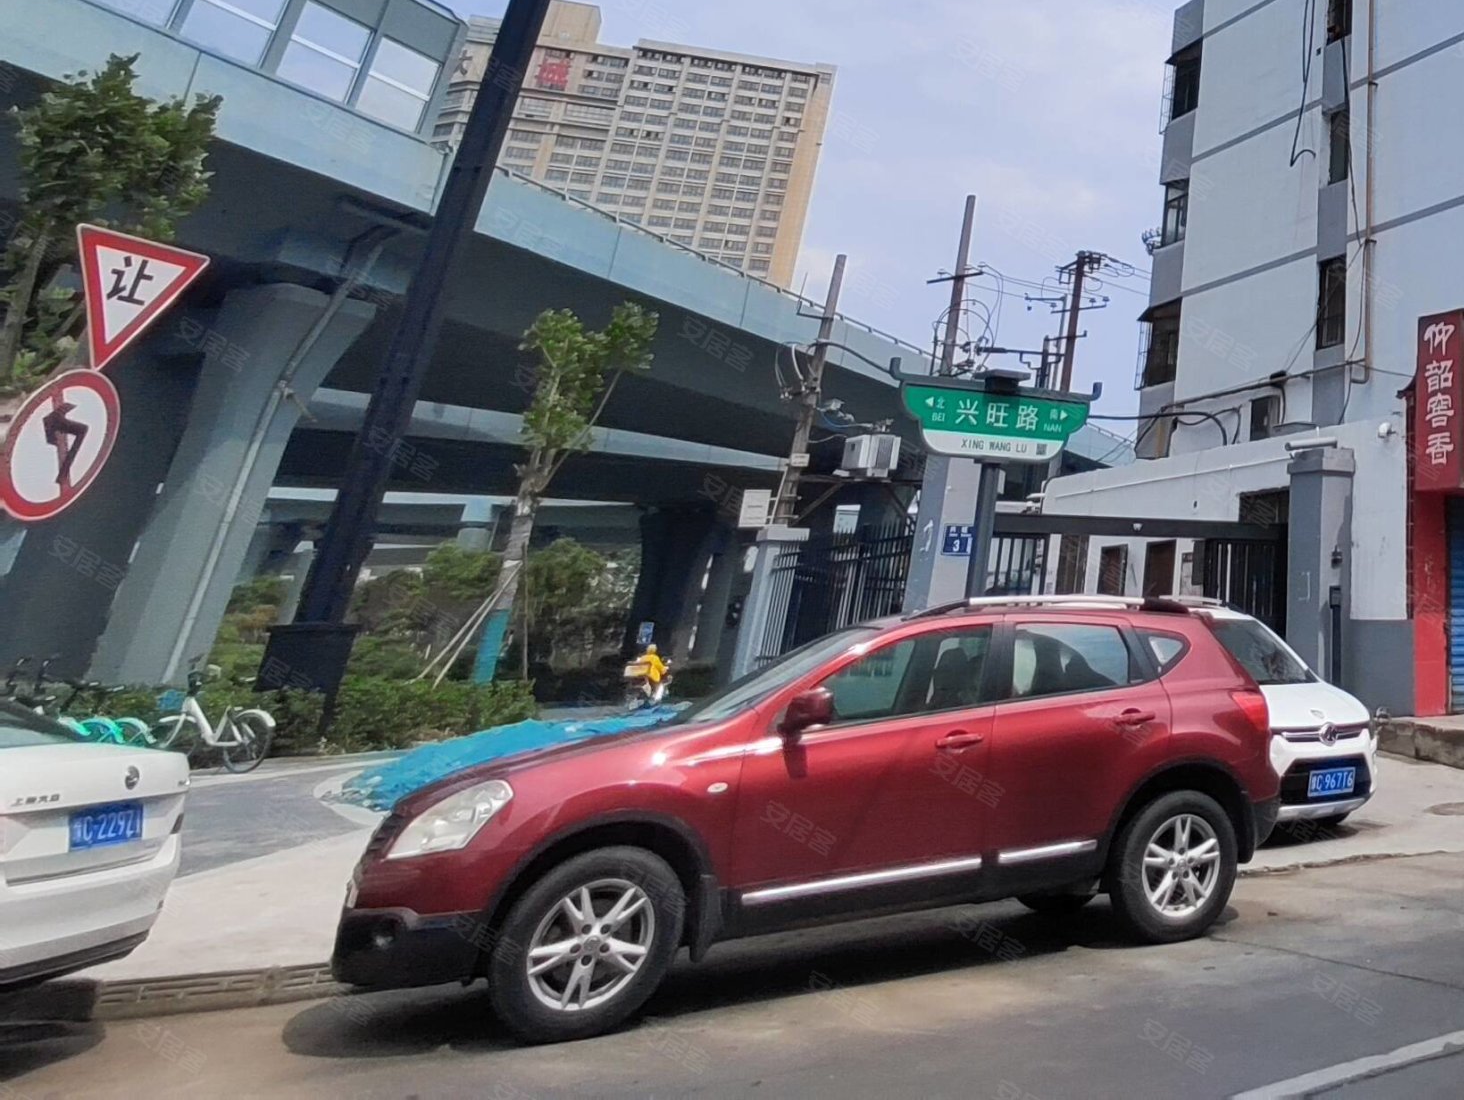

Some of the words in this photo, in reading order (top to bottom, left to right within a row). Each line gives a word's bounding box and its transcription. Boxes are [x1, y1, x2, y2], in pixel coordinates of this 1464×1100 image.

[106, 255, 154, 307] 让
[1424, 321, 1455, 466] 仰韶窖香
[931, 412, 945, 422] BEI
[955, 399, 1039, 432] 兴旺路
[1043, 422, 1062, 433] NAN
[961, 438, 985, 450] XING
[989, 440, 1011, 453] WANG
[1015, 442, 1028, 453] LU
